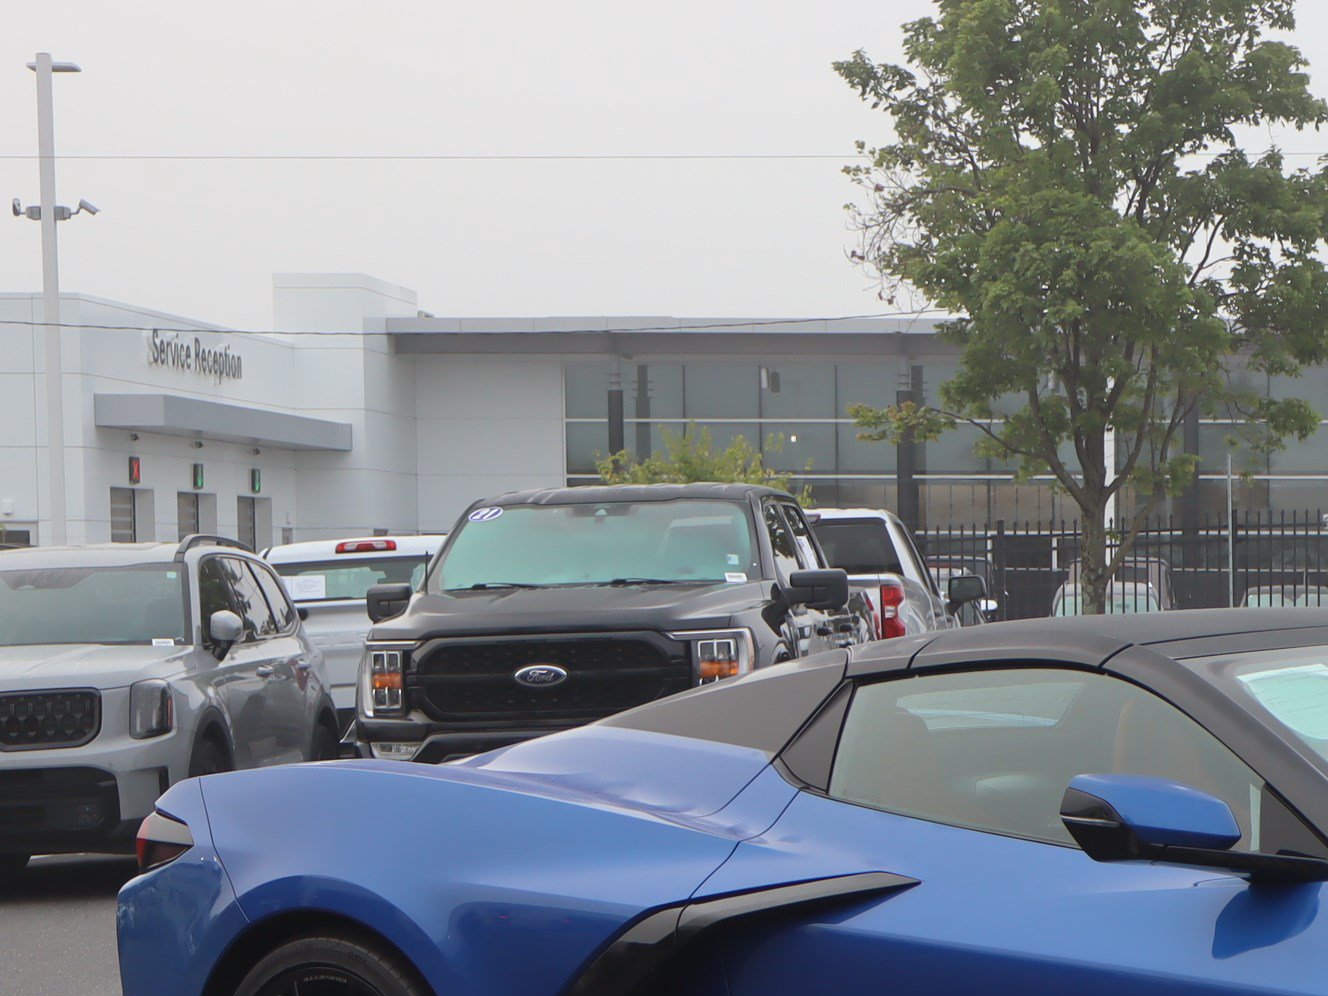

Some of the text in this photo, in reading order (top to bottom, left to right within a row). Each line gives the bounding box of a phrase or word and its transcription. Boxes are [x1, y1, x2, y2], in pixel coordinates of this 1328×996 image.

[152, 328, 242, 385] Service Reception
[527, 669, 554, 683] Ford
